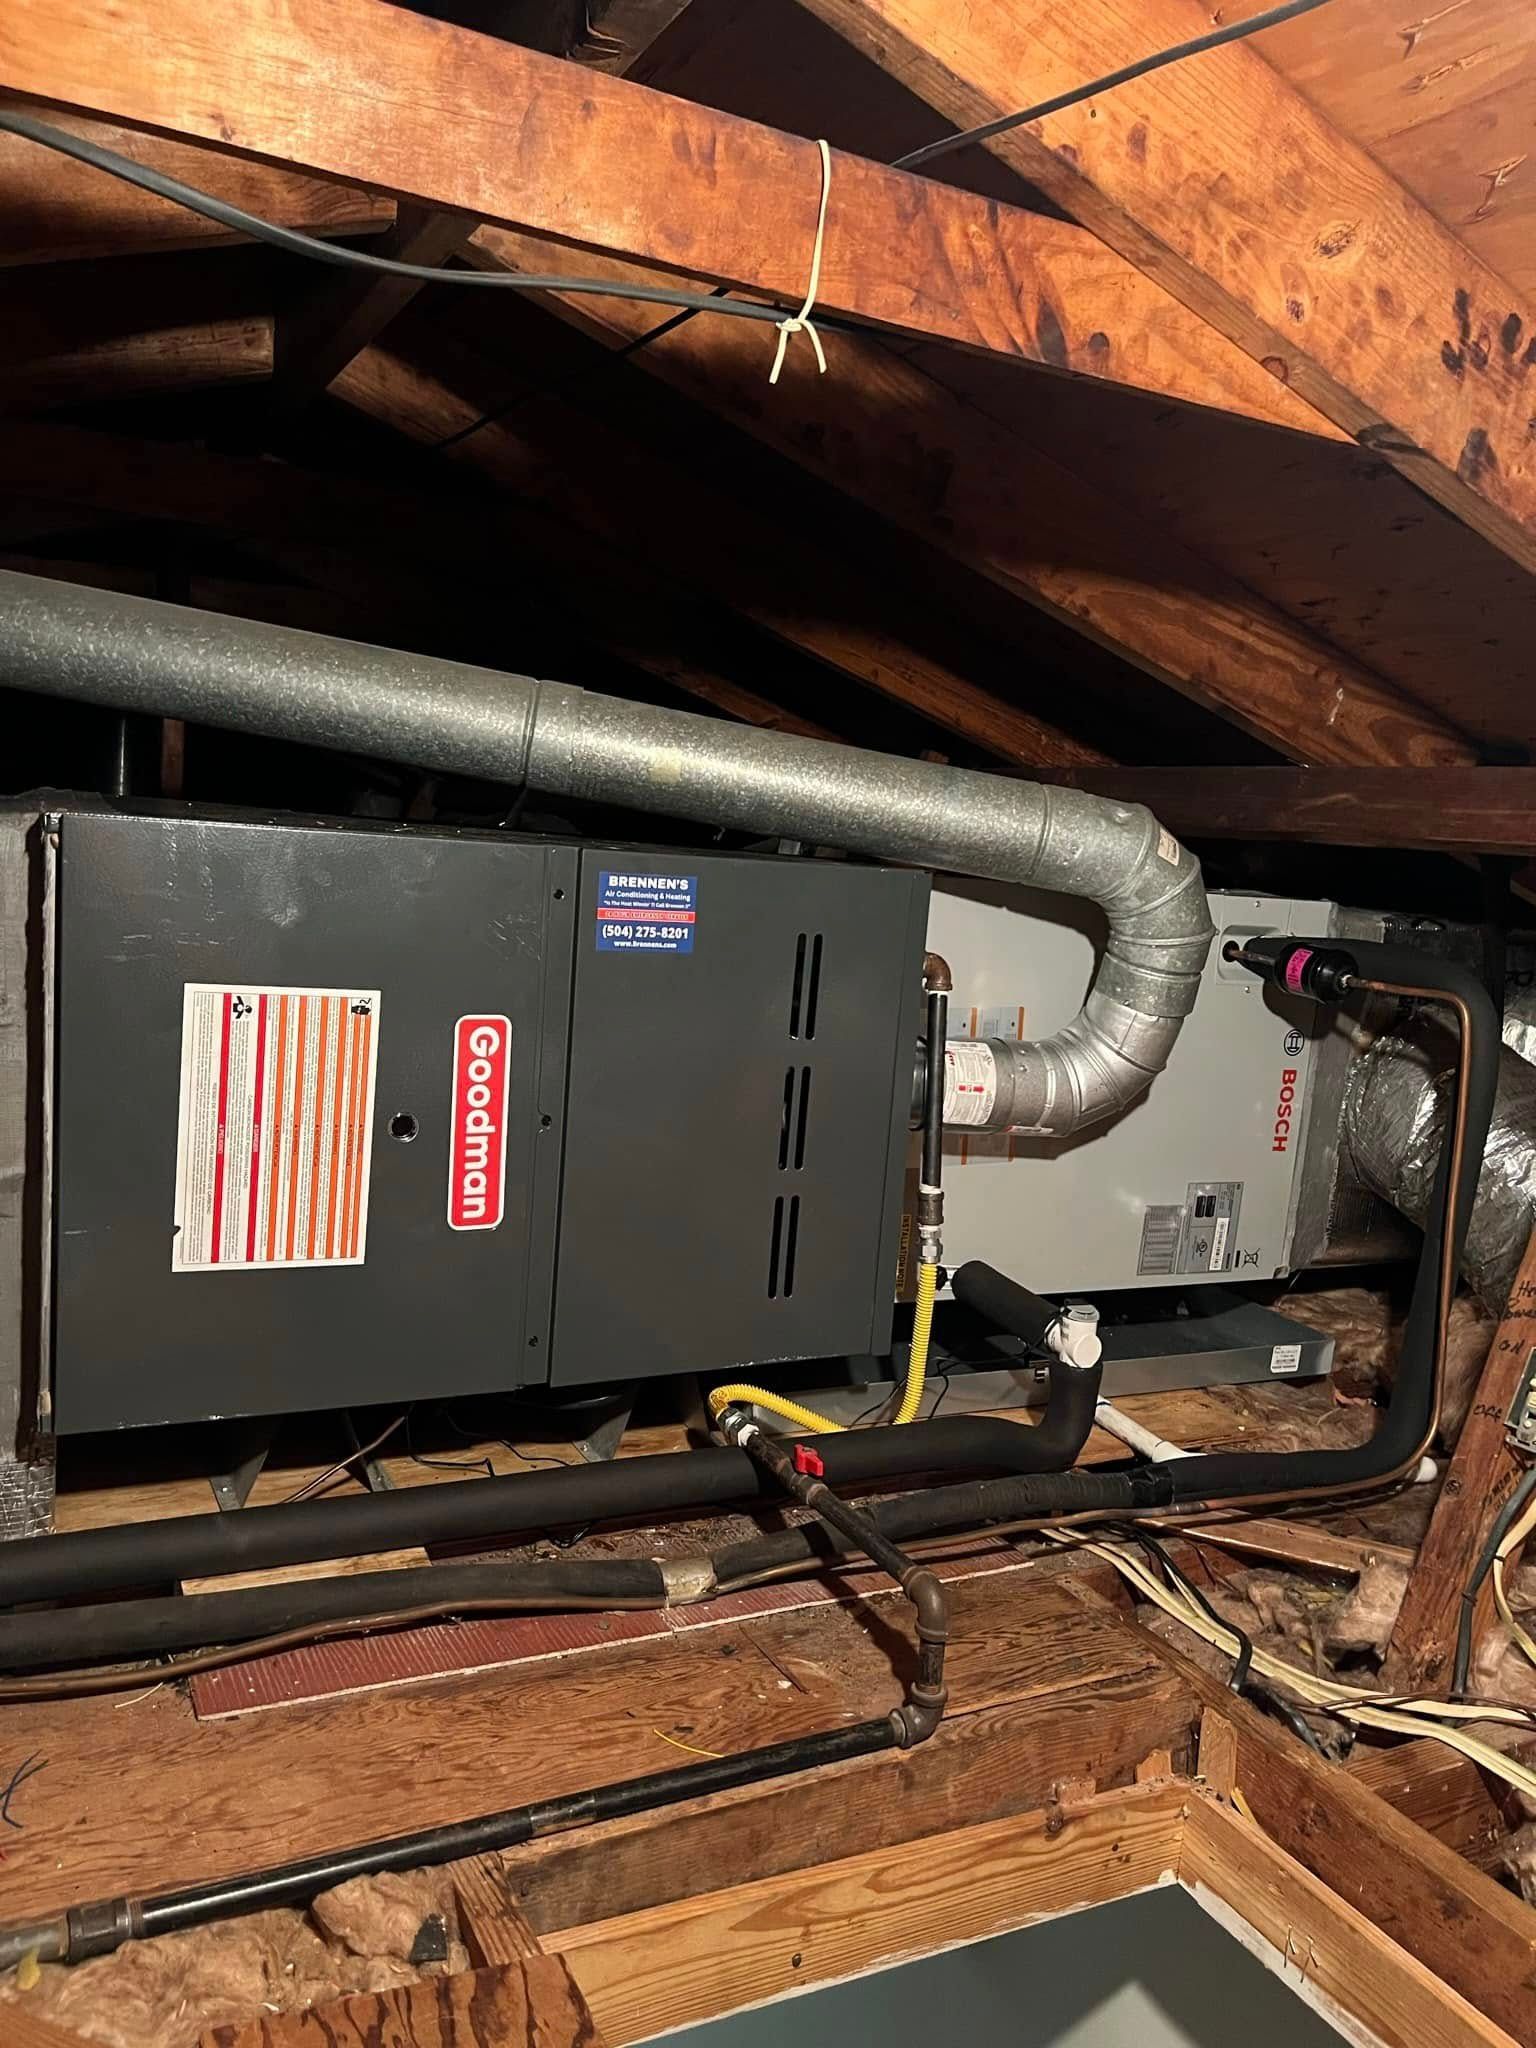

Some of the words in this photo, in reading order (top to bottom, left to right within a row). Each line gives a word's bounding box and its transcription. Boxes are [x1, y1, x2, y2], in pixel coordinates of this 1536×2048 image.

[608, 875, 689, 890] BRENNEN'S
[605, 889, 615, 897] Air
[616, 890, 658, 901] Conditioning
[659, 892, 665, 900] &
[665, 893, 691, 902] Heating
[602, 924, 633, 939] (504)
[635, 926, 689, 939] 275-8201
[613, 940, 677, 948] www.Brennens.com
[1272, 1069, 1297, 1151] BOSCH
[462, 1026, 500, 1219] Goodman
